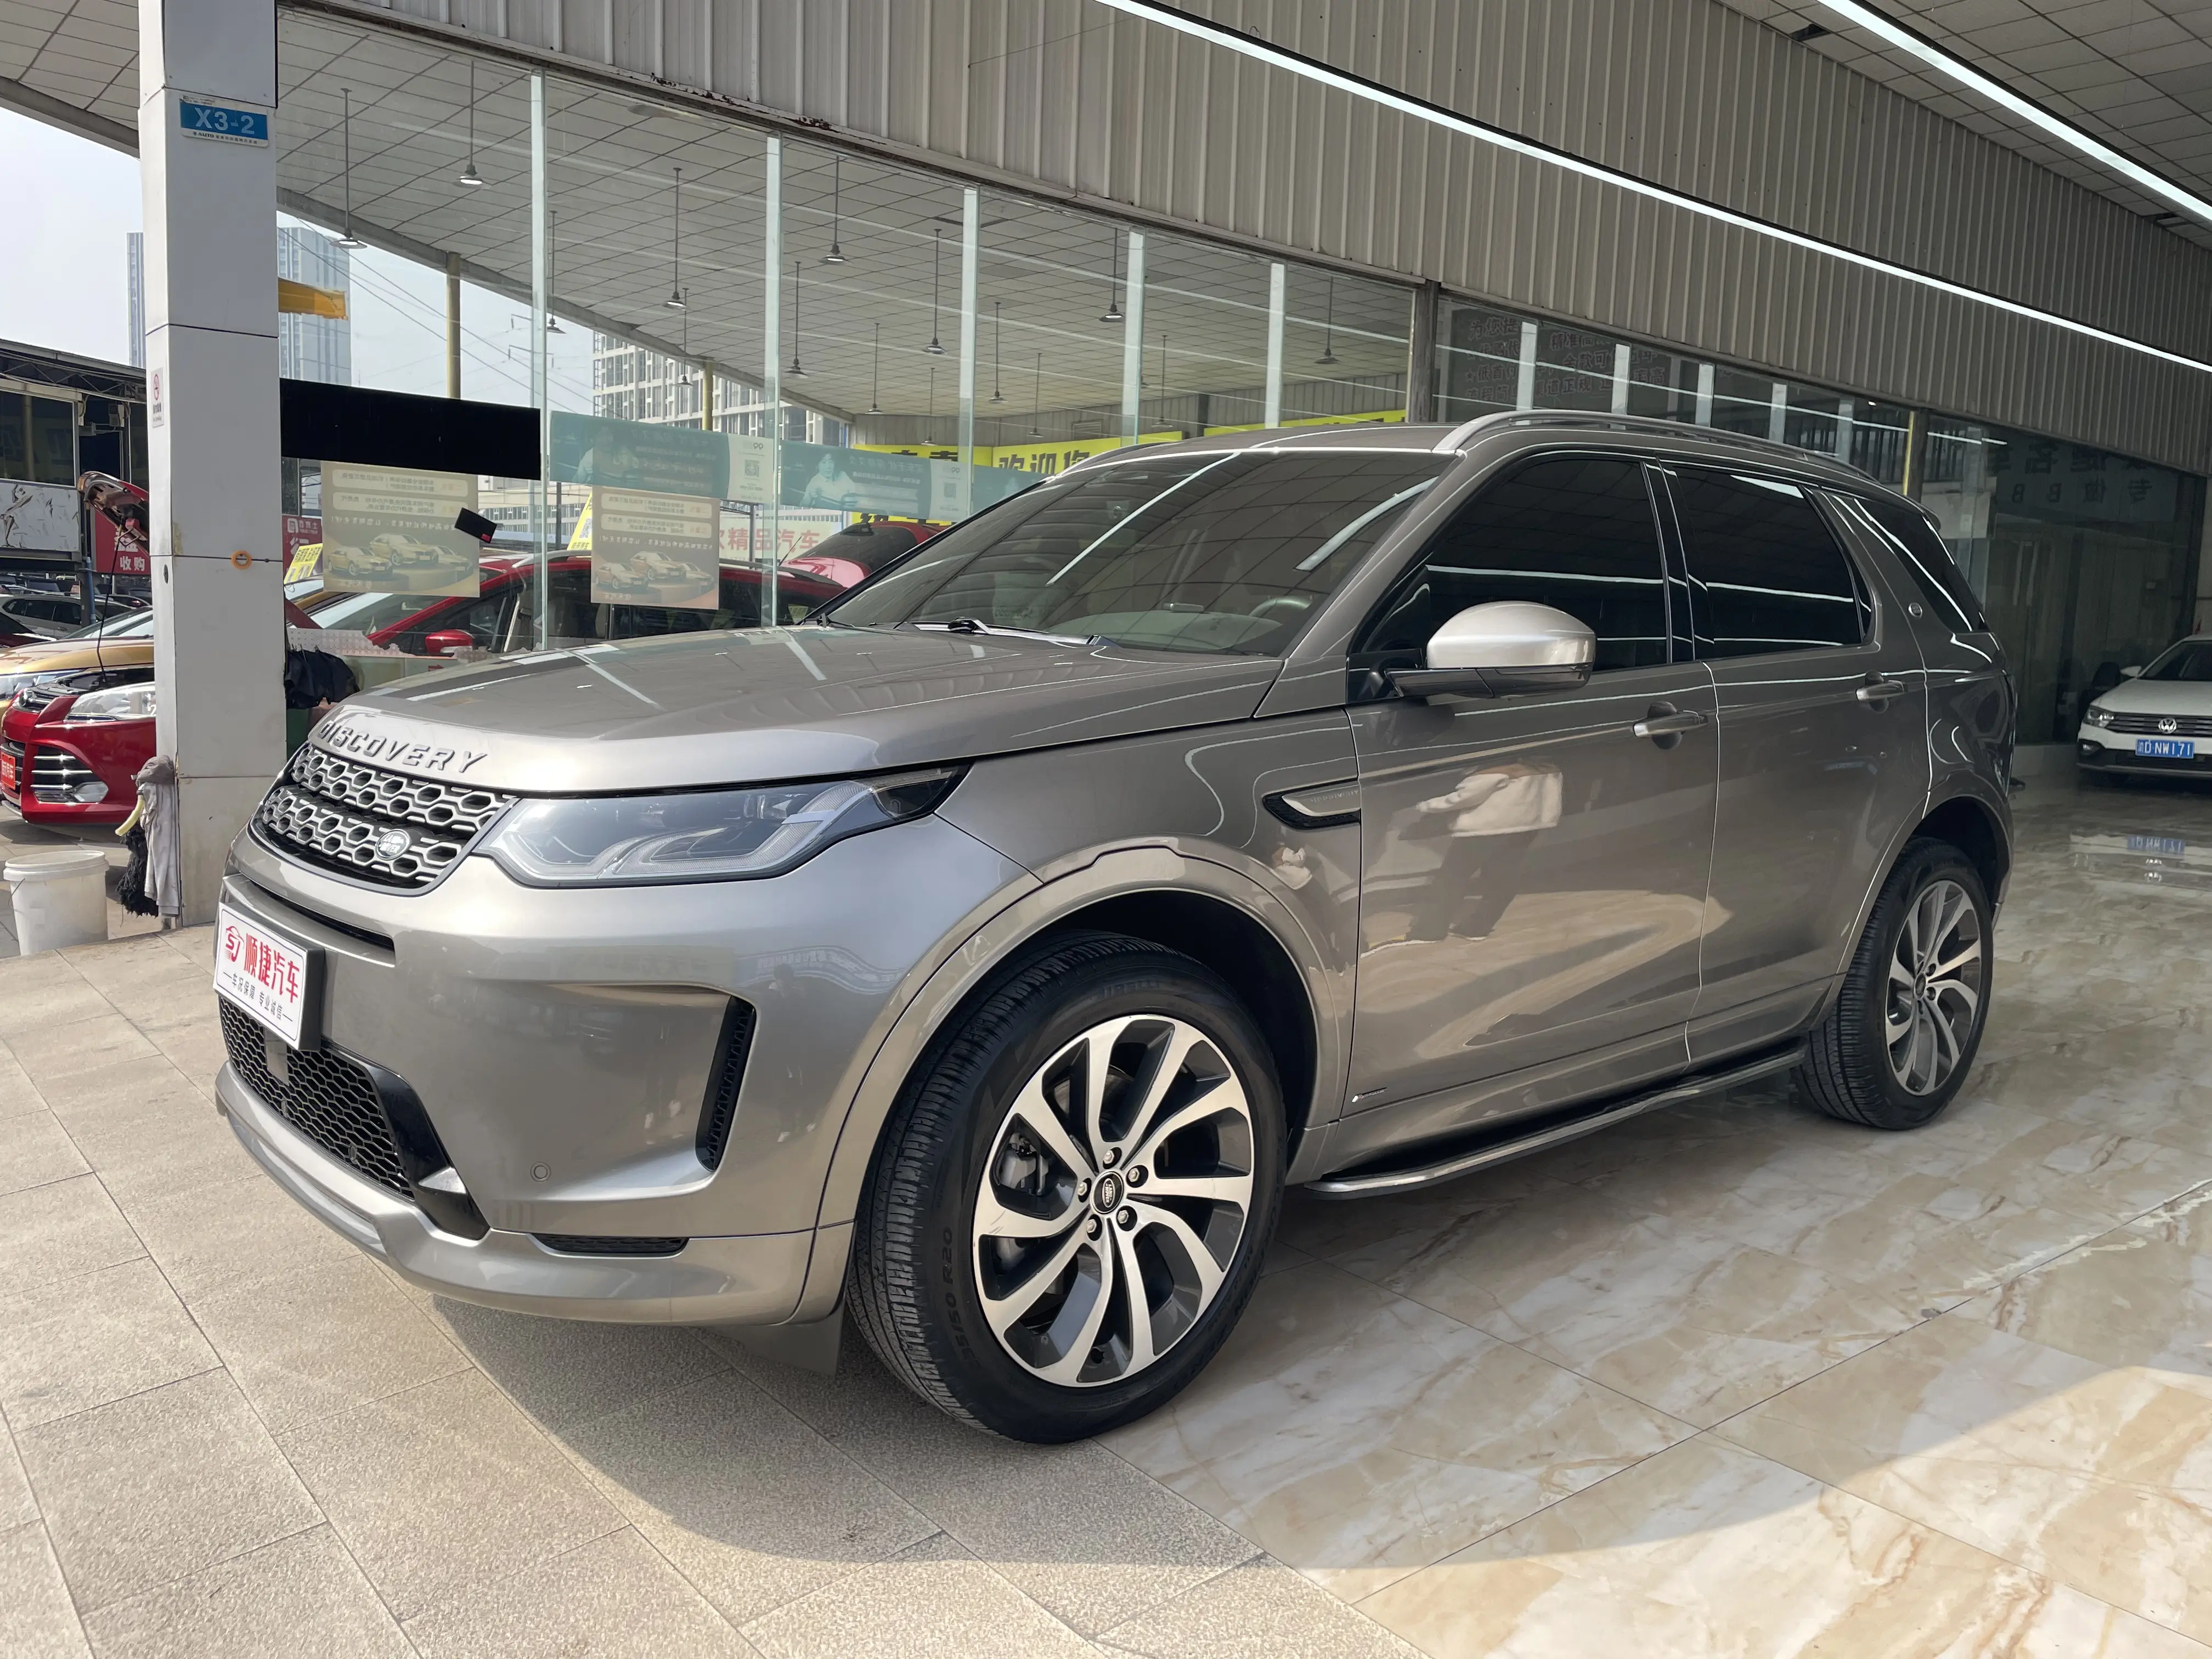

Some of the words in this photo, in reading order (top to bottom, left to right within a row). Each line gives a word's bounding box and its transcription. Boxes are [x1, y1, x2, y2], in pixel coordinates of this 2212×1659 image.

[195, 107, 255, 134] X3-2
[120, 556, 145, 572] 收购
[318, 720, 488, 773] DISCOVERY
[244, 933, 300, 1003] 顺捷汽车
[232, 973, 256, 999] 车况保障
[259, 991, 283, 1020] 专业诚信
[942, 1227, 953, 1285] R20
